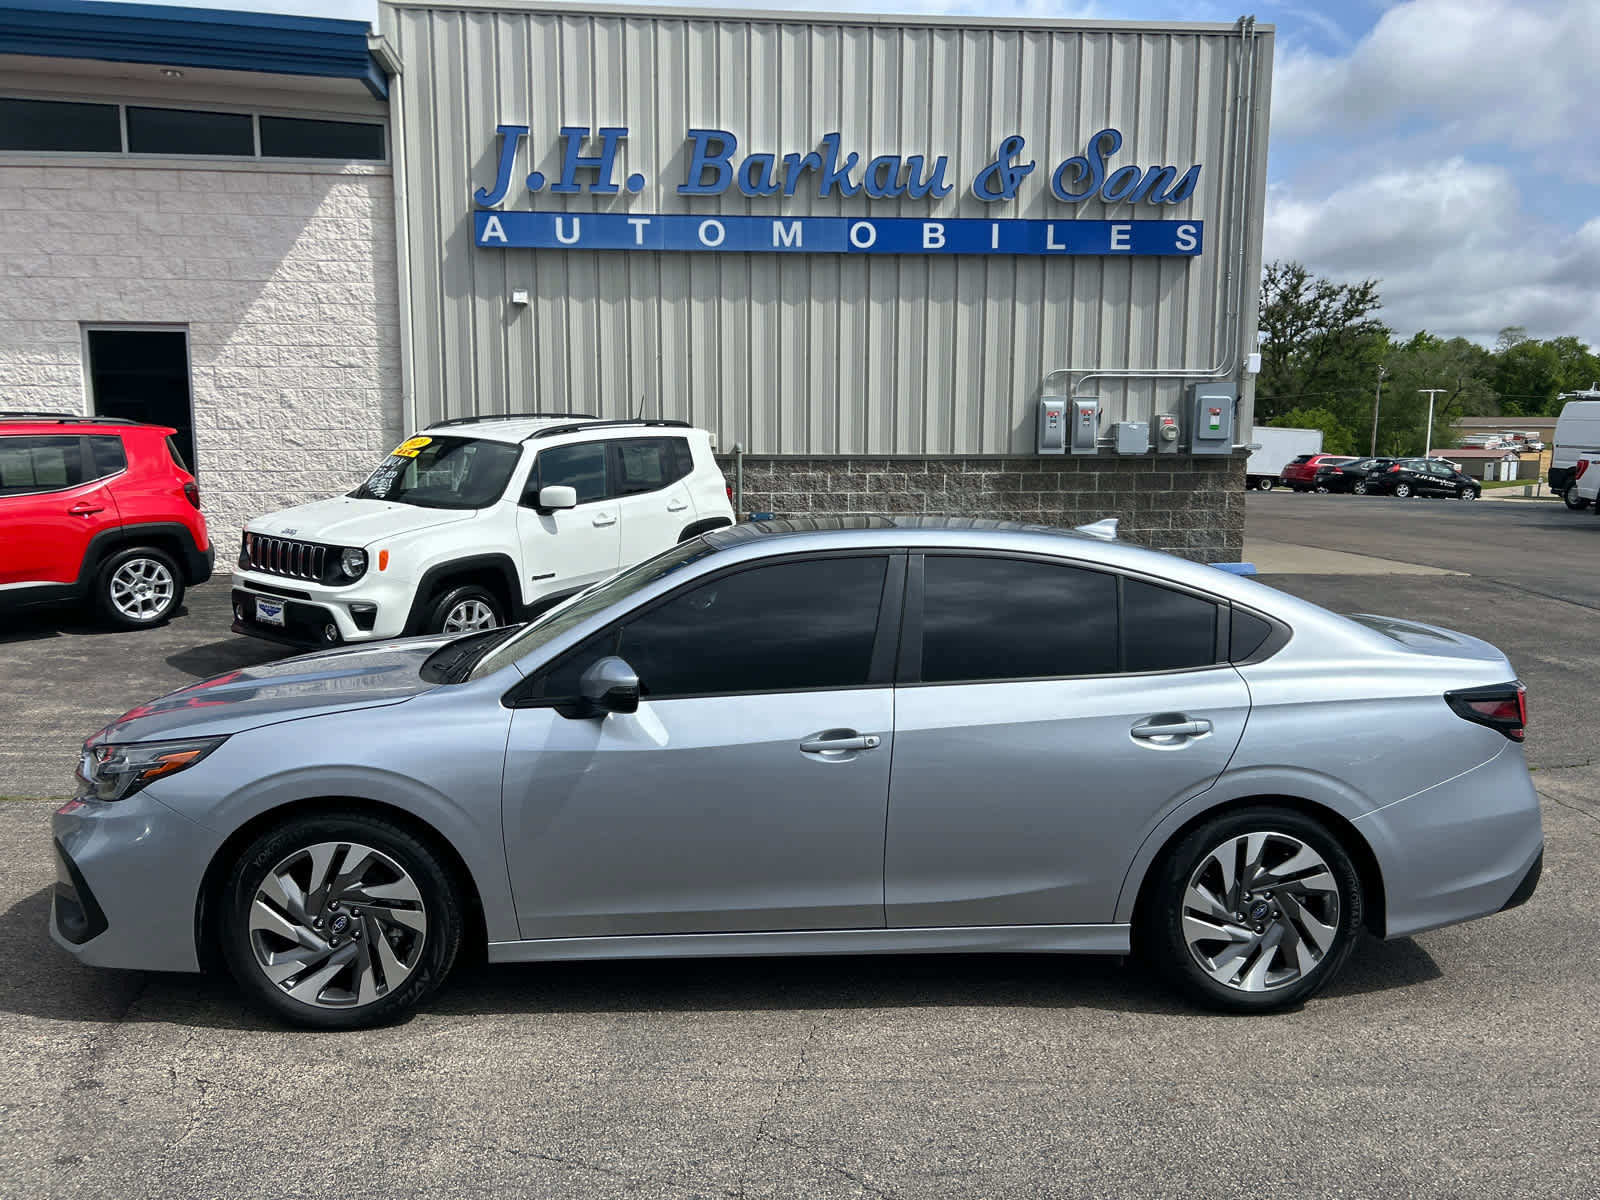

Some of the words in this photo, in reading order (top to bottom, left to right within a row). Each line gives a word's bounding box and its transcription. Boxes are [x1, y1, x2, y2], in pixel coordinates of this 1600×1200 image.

[474, 125, 646, 208] J.H.
[677, 129, 954, 200] Barkau
[973, 135, 1036, 201] &
[1051, 128, 1202, 204] Sons
[481, 215, 1198, 251] AUTOMOBILES
